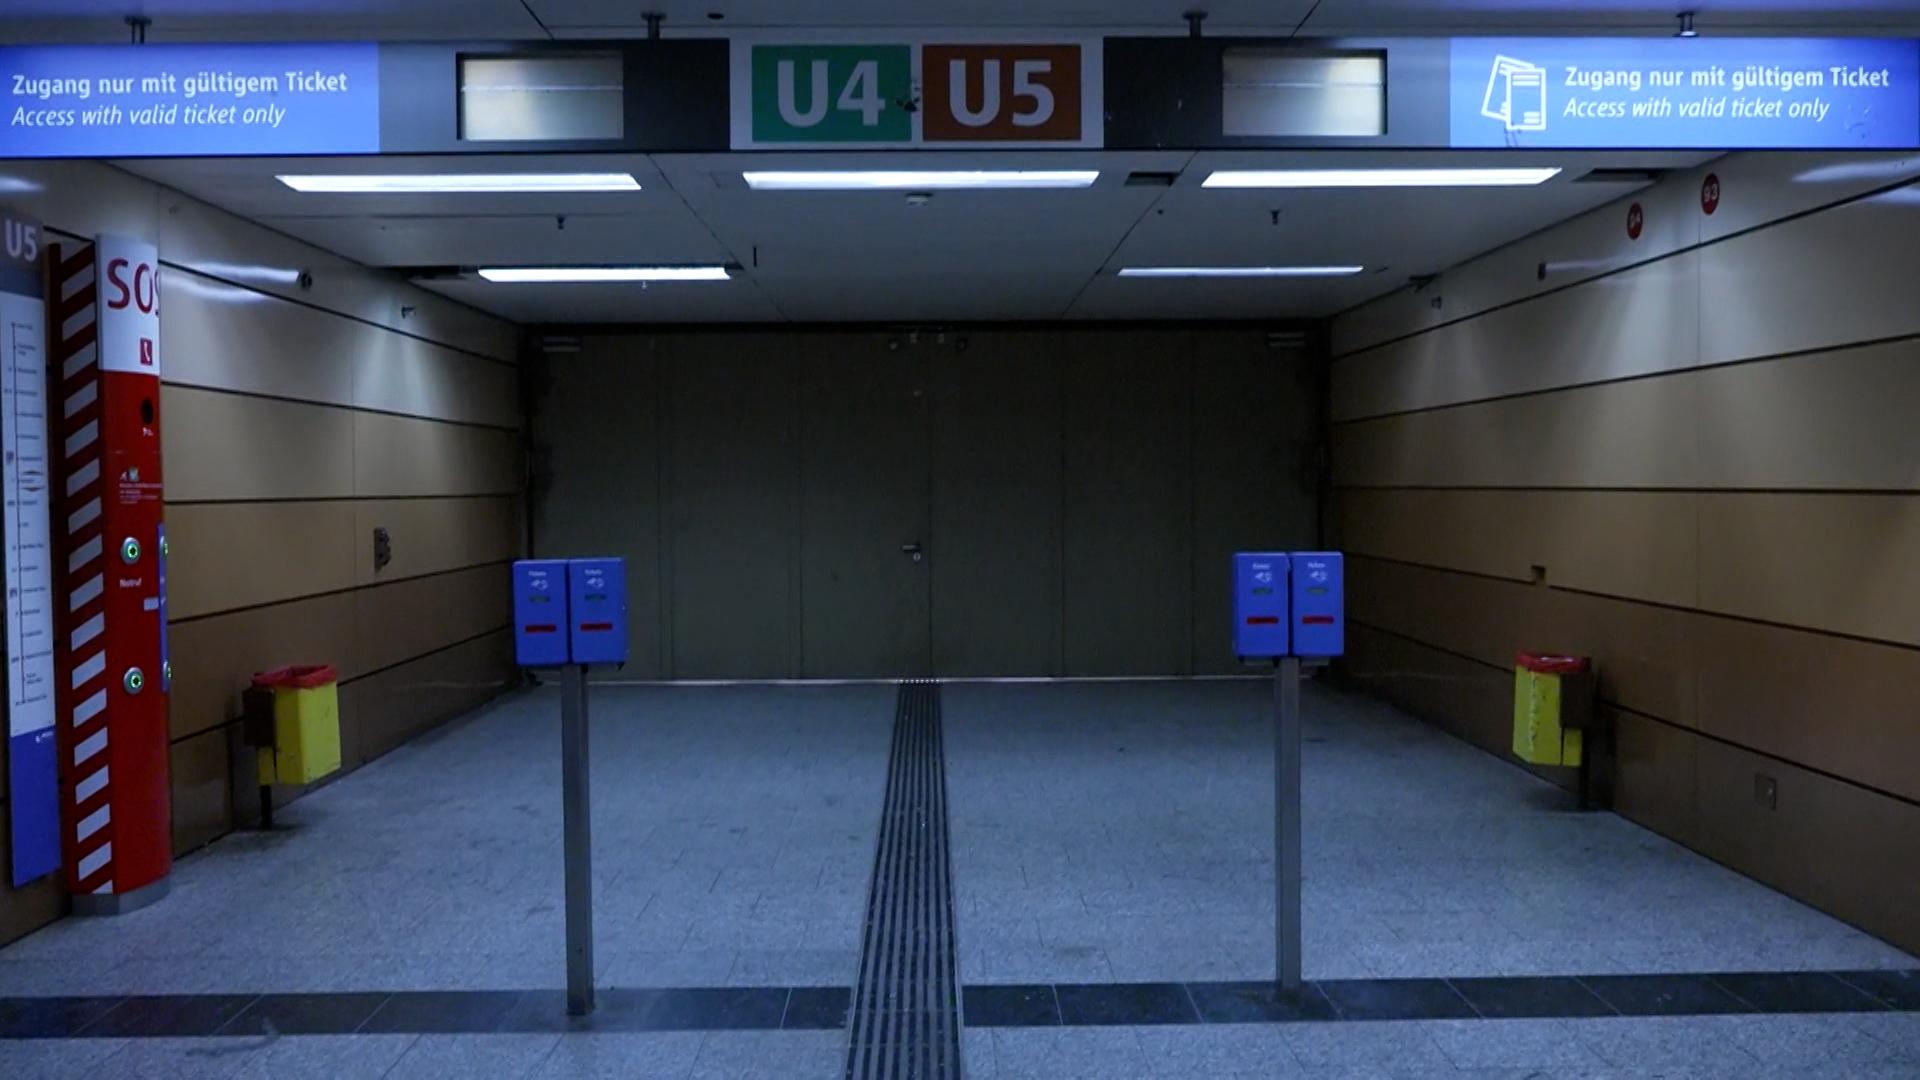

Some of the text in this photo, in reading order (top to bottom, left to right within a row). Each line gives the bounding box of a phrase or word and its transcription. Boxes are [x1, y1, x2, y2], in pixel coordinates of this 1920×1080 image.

[12, 72, 347, 99] Zugang nur mit gültigem Ticket
[1564, 66, 1889, 90] Zugang nur mit gültigem Ticket
[777, 59, 1054, 127] U4 U5
[12, 104, 286, 128] Access with valid ticket only
[1563, 97, 1830, 122] Access with valid ticket only
[5, 219, 37, 262] U5
[107, 257, 159, 318] SO
